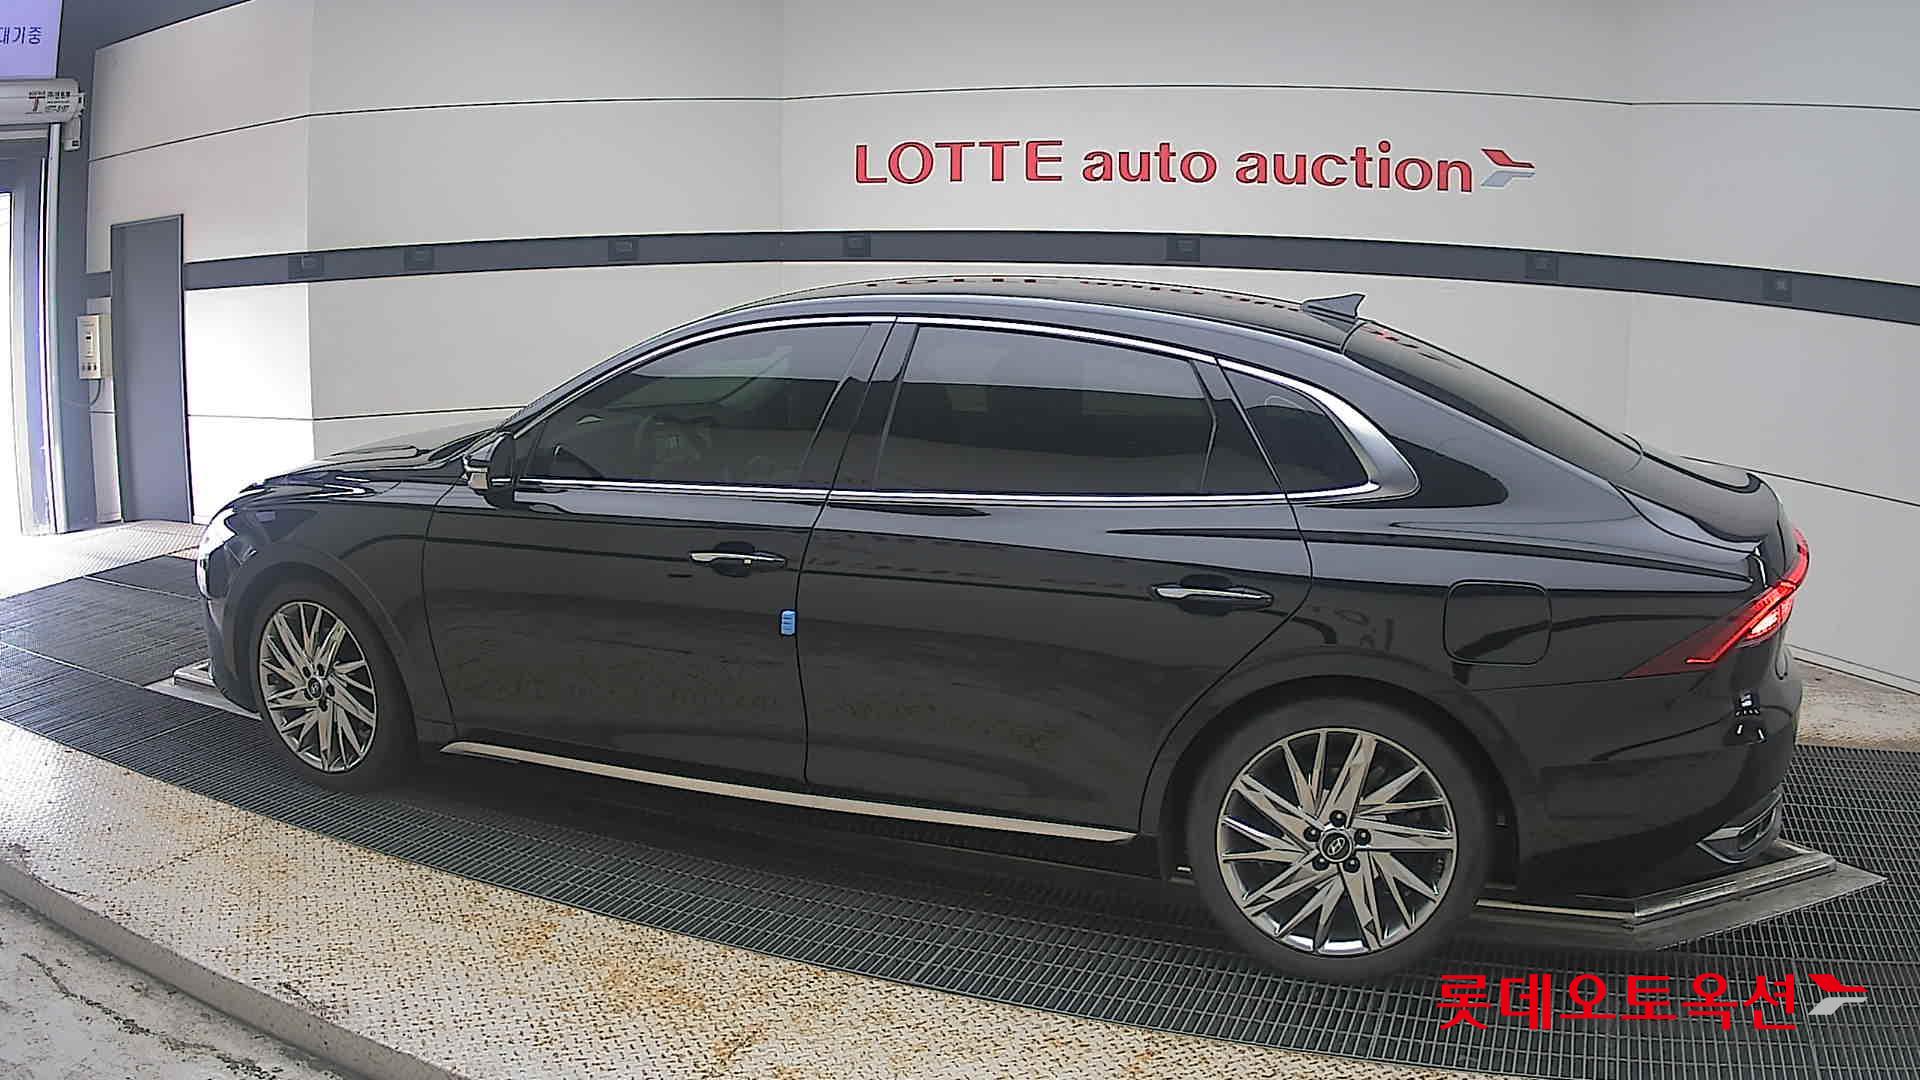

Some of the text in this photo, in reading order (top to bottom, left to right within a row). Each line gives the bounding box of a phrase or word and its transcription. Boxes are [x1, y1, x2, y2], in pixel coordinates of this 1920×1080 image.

[855, 140, 1473, 192] LOTTE auto auction
